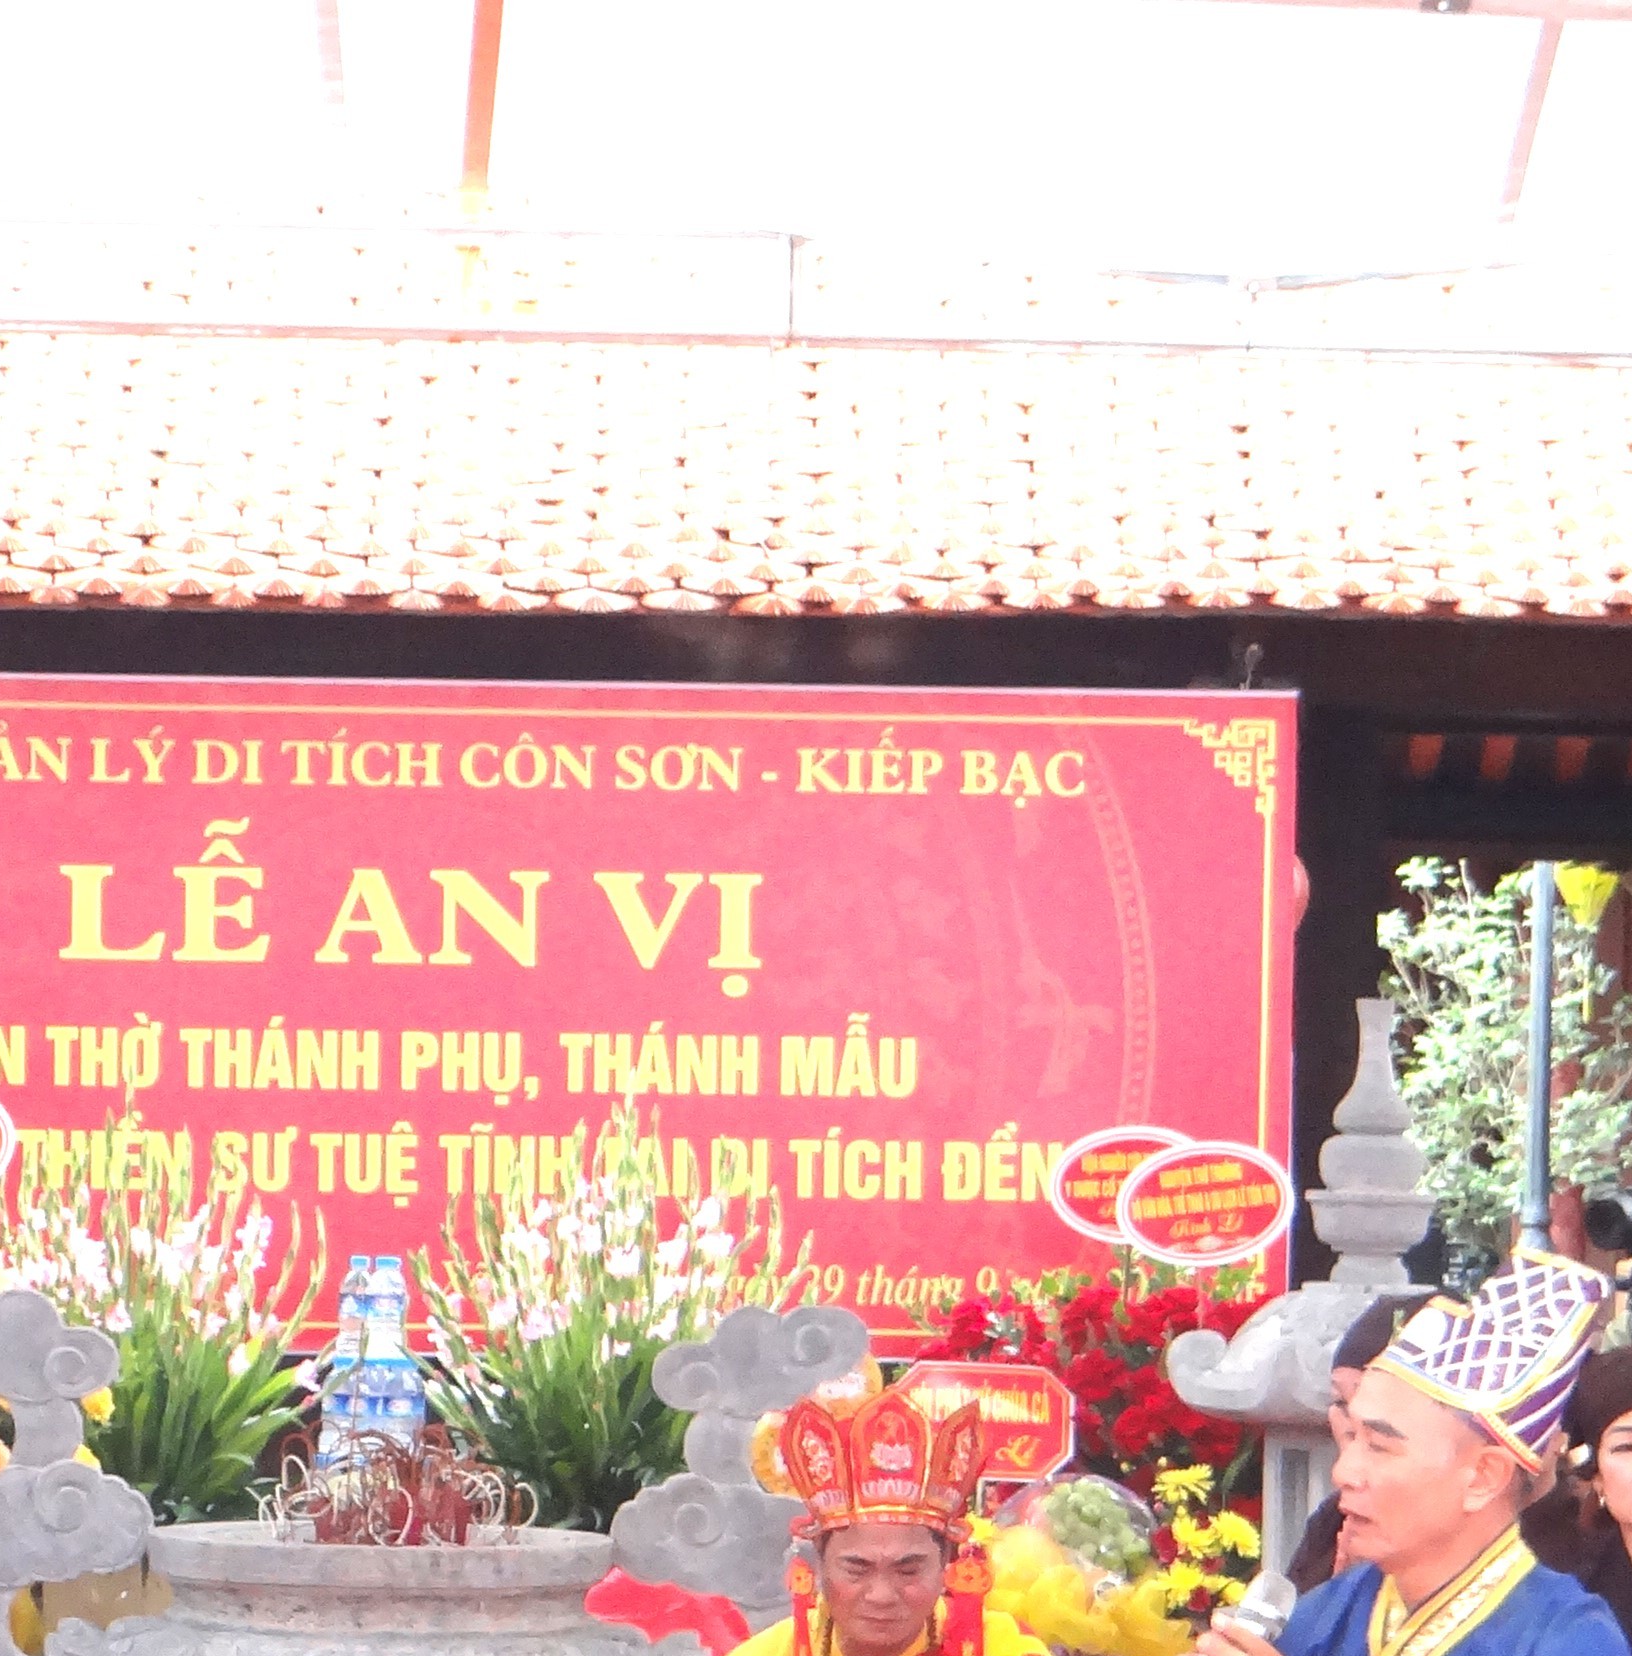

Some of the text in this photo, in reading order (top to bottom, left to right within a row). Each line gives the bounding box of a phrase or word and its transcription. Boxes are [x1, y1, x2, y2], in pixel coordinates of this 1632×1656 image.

[91, 725, 173, 784] LÝ
[194, 739, 262, 785] DI
[282, 728, 442, 787] TÍCH
[459, 731, 596, 788] CÔN
[615, 744, 742, 790] SƠN
[798, 726, 943, 794] KIẾP
[962, 749, 1086, 808] BẠC
[59, 818, 762, 998] LỄ AN VỊ
[44, 1012, 163, 1089] THỜ
[179, 1016, 380, 1091] THÁNH
[400, 1030, 541, 1106] PHỤ,
[559, 1021, 761, 1098] THÁNH
[779, 1012, 918, 1099] MẪU
[15, 1109, 193, 1191] THIỀN
[213, 1126, 299, 1194] SƯ
[309, 1121, 419, 1208] TUỆ
[438, 1122, 579, 1196] TĨNH
[710, 1136, 769, 1200] DI
[788, 1126, 924, 1201] TÍCH
[940, 1120, 1066, 1202] ĐỀN
